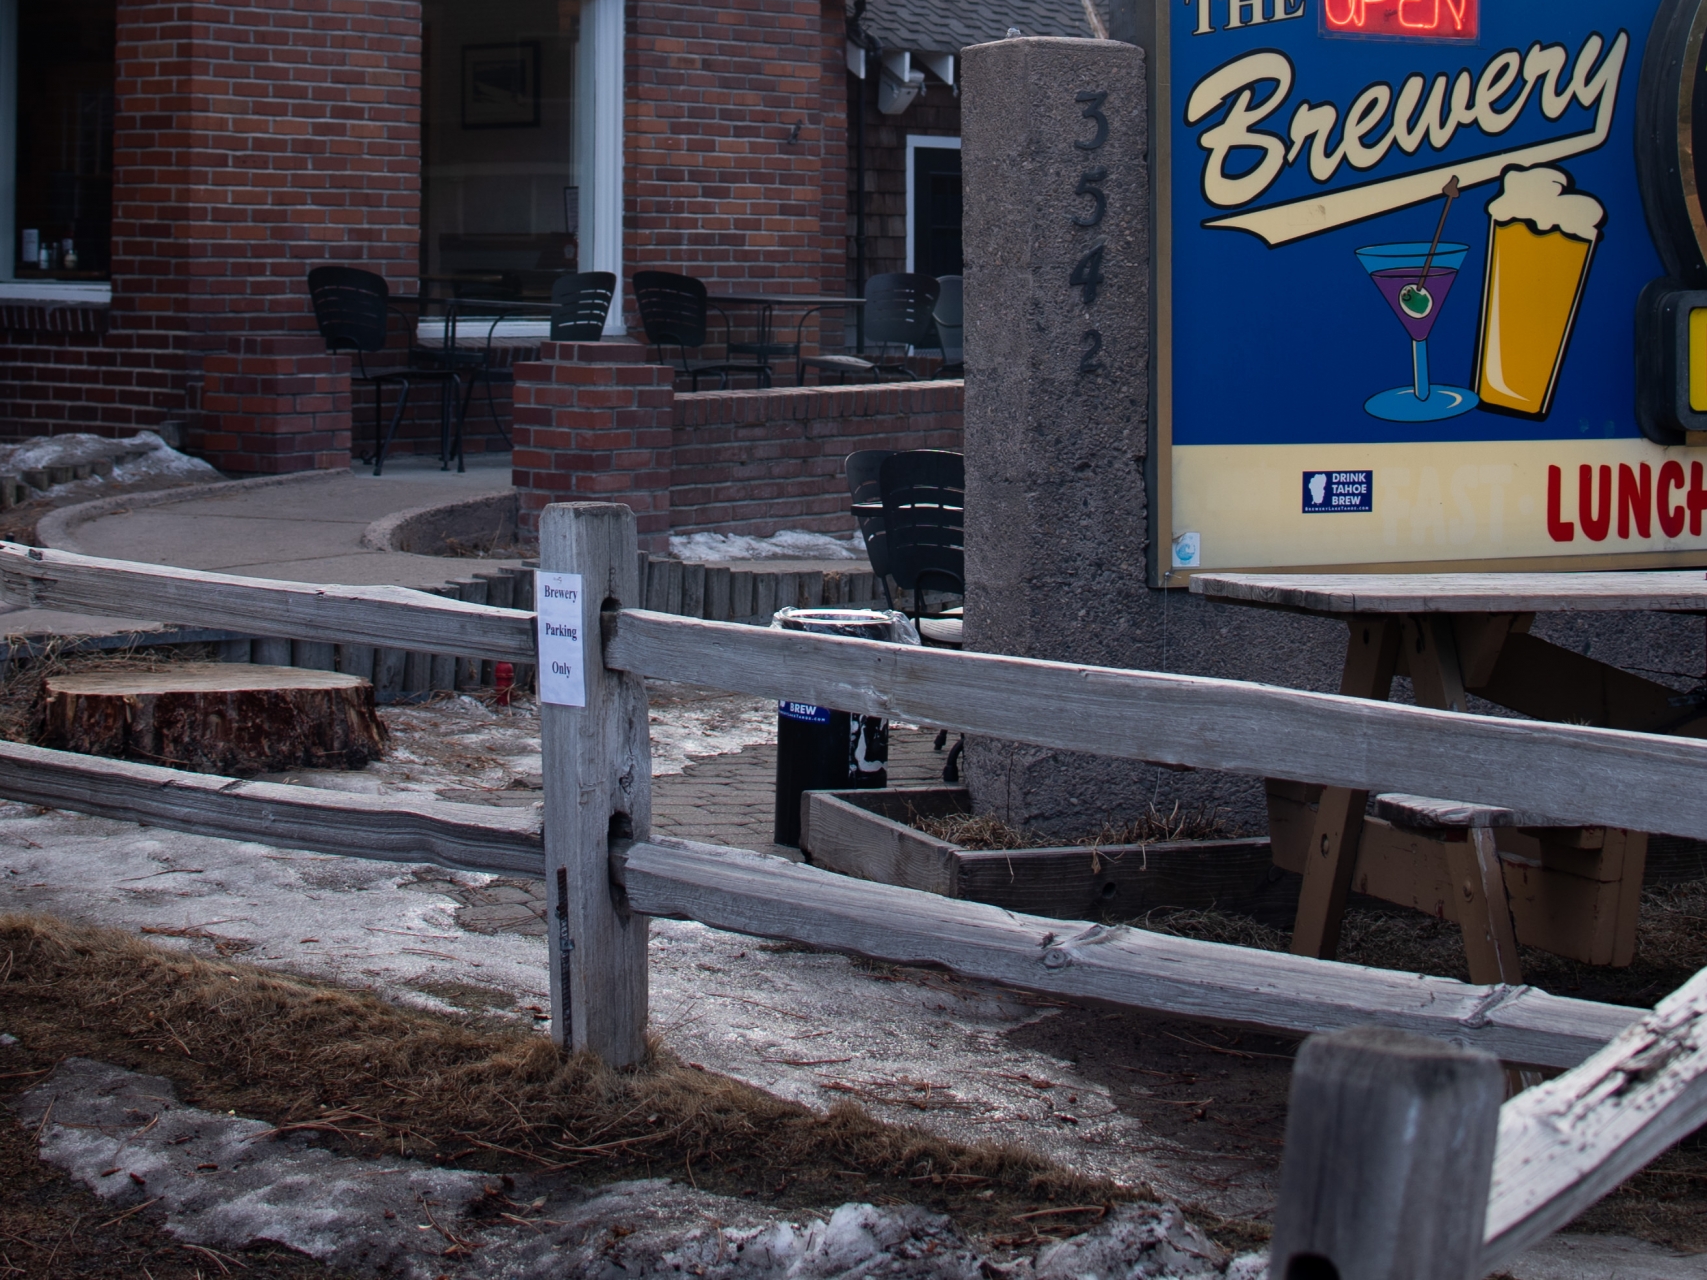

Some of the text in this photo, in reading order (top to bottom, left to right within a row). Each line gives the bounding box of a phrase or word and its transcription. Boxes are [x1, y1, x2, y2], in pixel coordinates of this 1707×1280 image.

[1185, 29, 1629, 244] Brewery
[1332, 473, 1366, 482] DRINK
[1332, 484, 1367, 494] TAHOE
[1332, 496, 1361, 505] BREW
[544, 584, 578, 604] Brewery
[545, 622, 578, 642] Parking
[551, 660, 572, 679] Only
[790, 702, 817, 716] BREW
